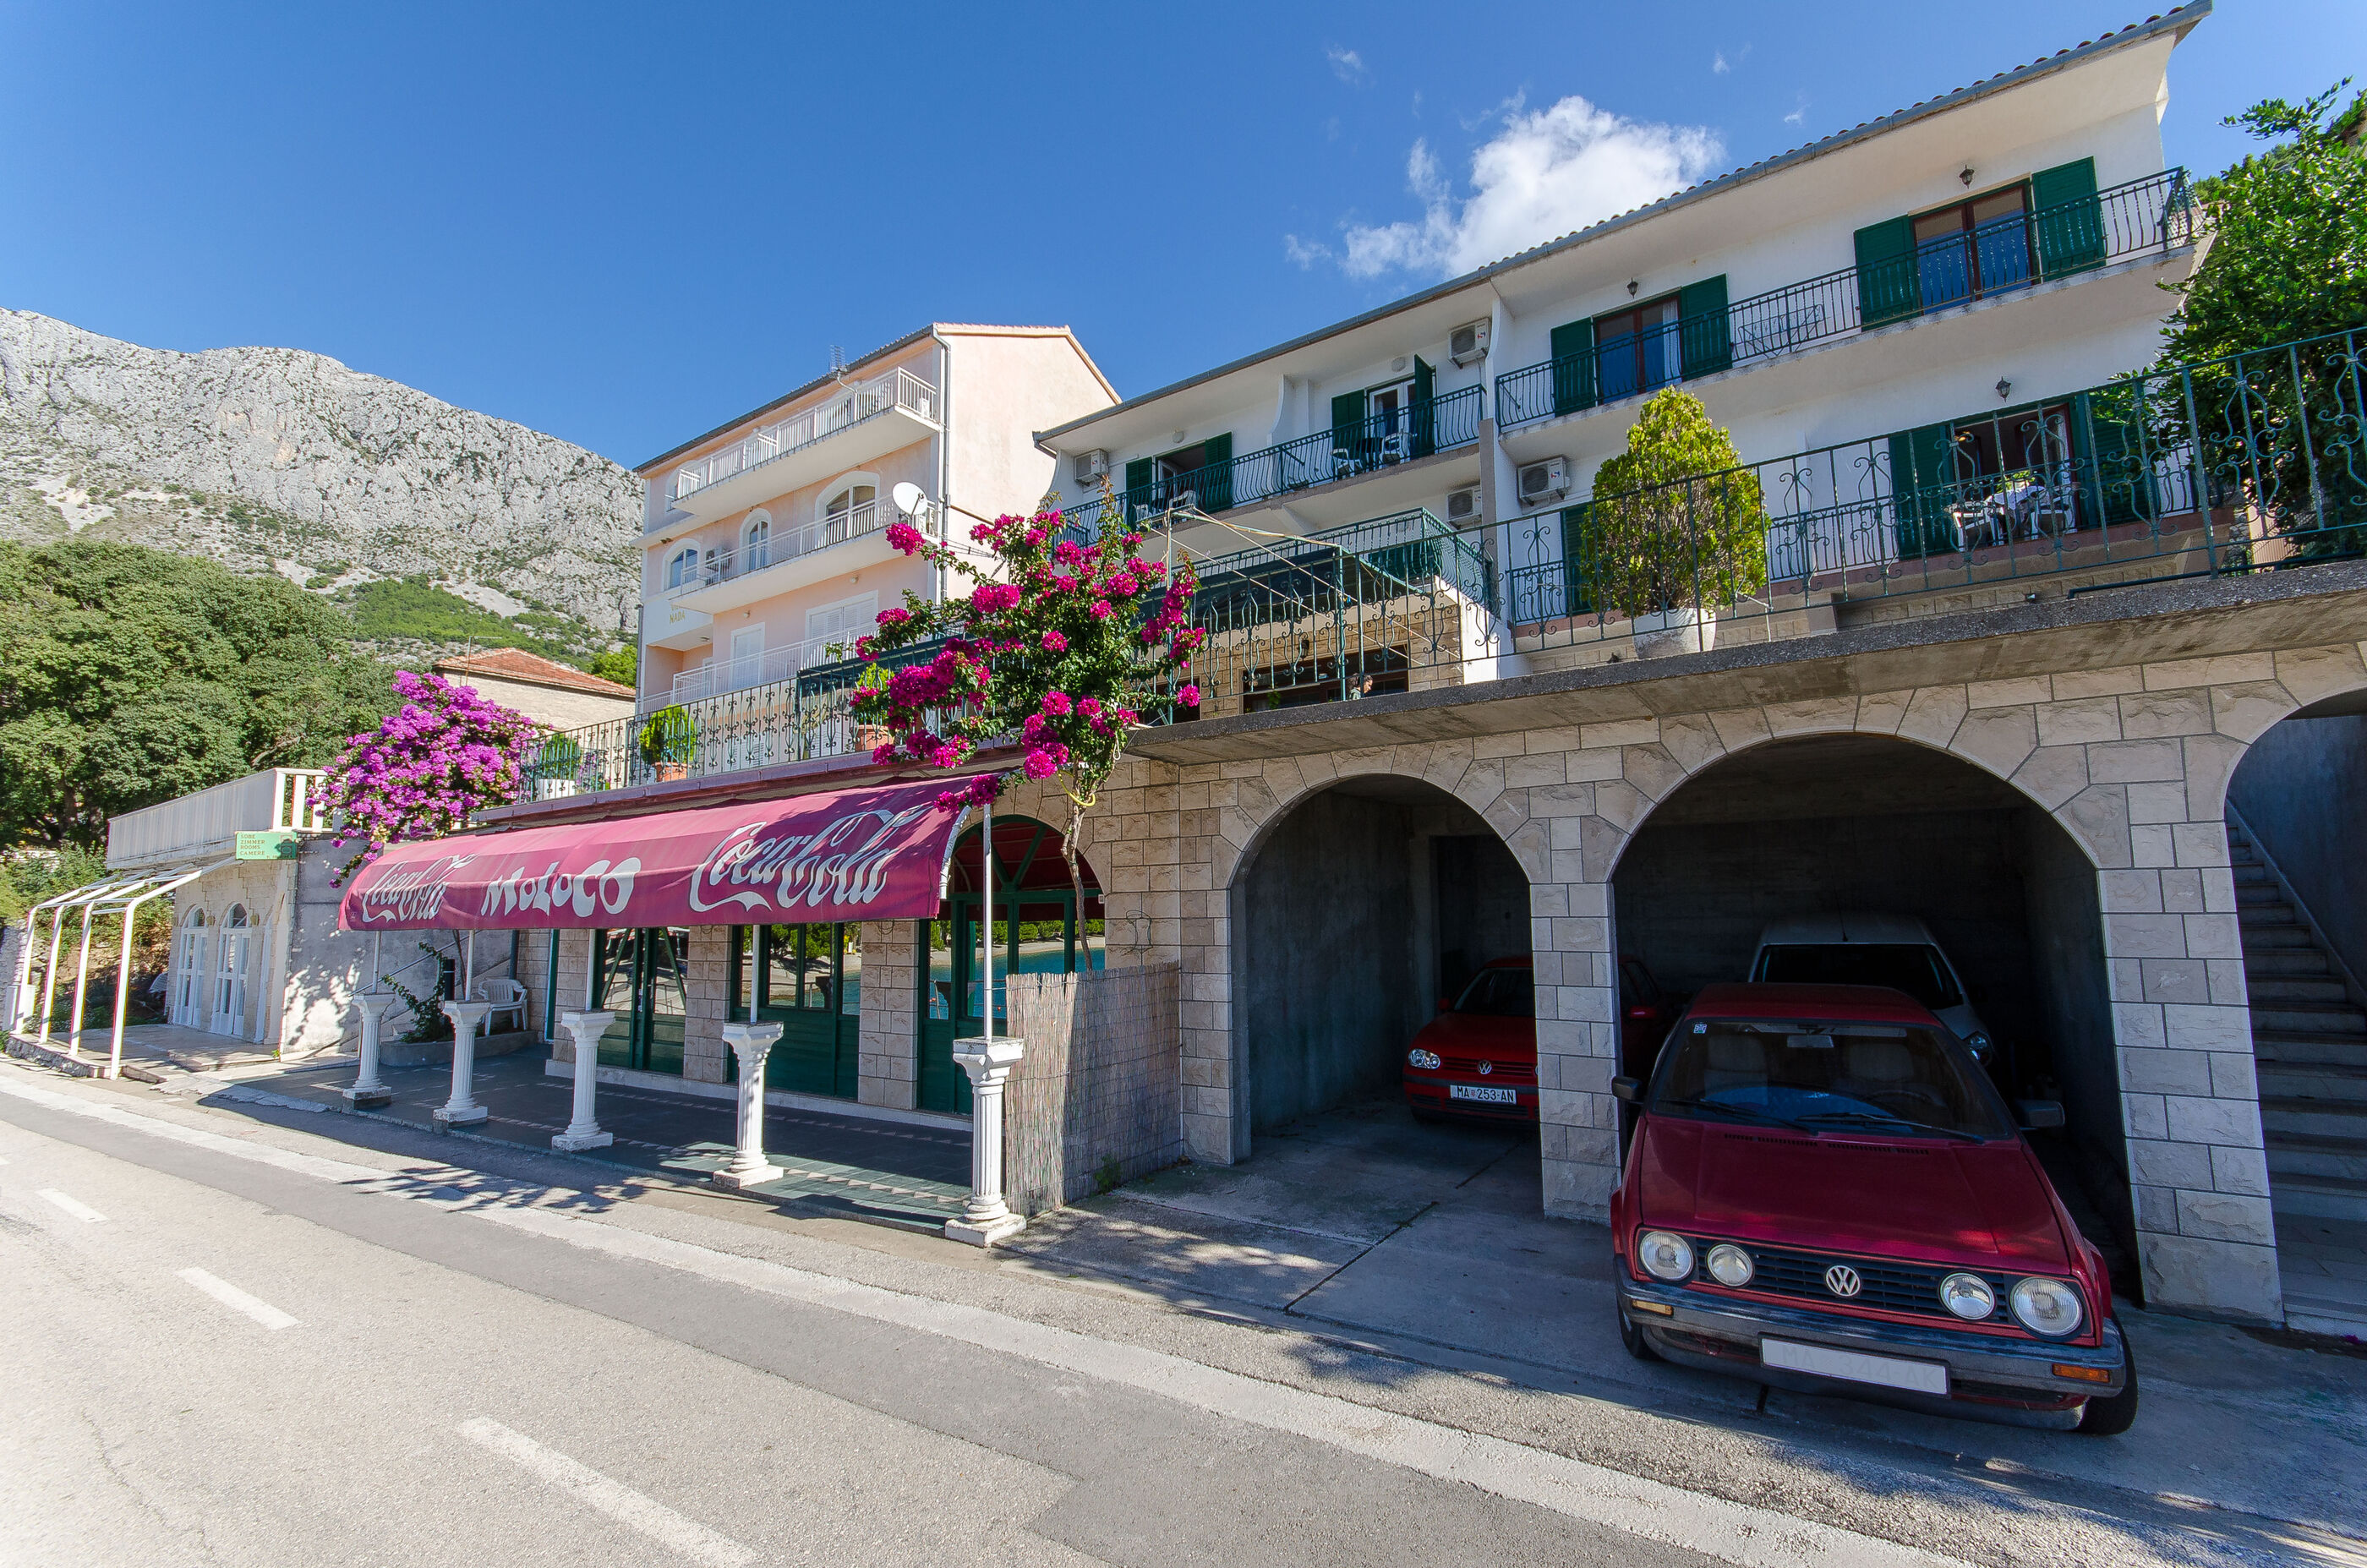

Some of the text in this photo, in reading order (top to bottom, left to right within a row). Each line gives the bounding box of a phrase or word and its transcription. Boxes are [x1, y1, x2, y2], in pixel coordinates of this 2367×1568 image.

[670, 610, 685, 624] NADA
[1457, 1086, 1515, 1103] MA 253-AN
